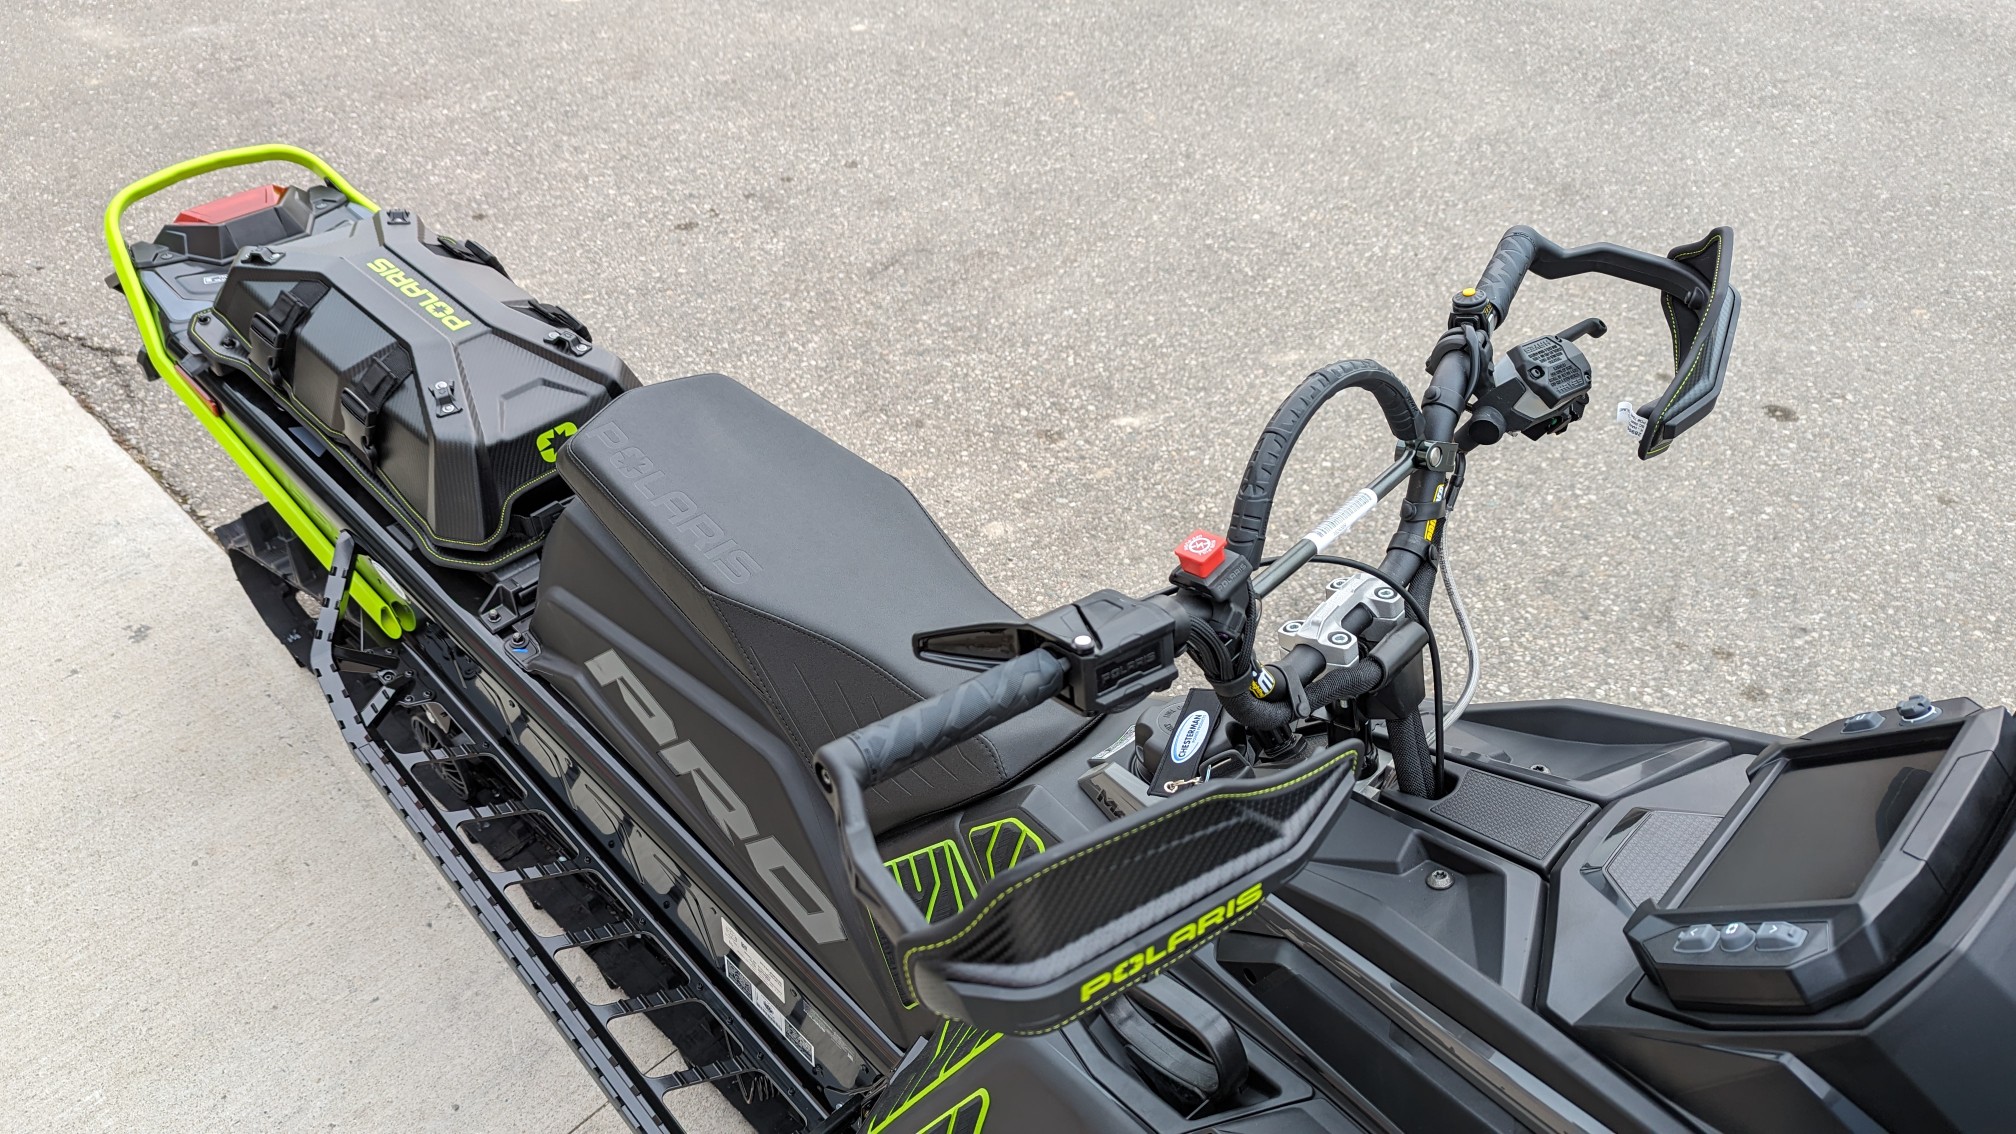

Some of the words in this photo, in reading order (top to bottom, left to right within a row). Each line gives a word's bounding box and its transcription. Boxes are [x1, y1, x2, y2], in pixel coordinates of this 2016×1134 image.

[366, 258, 471, 331] POLARIS
[585, 421, 764, 585] POLARIS
[1217, 563, 1247, 592] POLARIS
[1100, 651, 1157, 684] POLARIS
[1178, 714, 1203, 758] CHESTERMAN
[584, 648, 848, 945] PRO
[1080, 882, 1263, 1003] POLARIS
